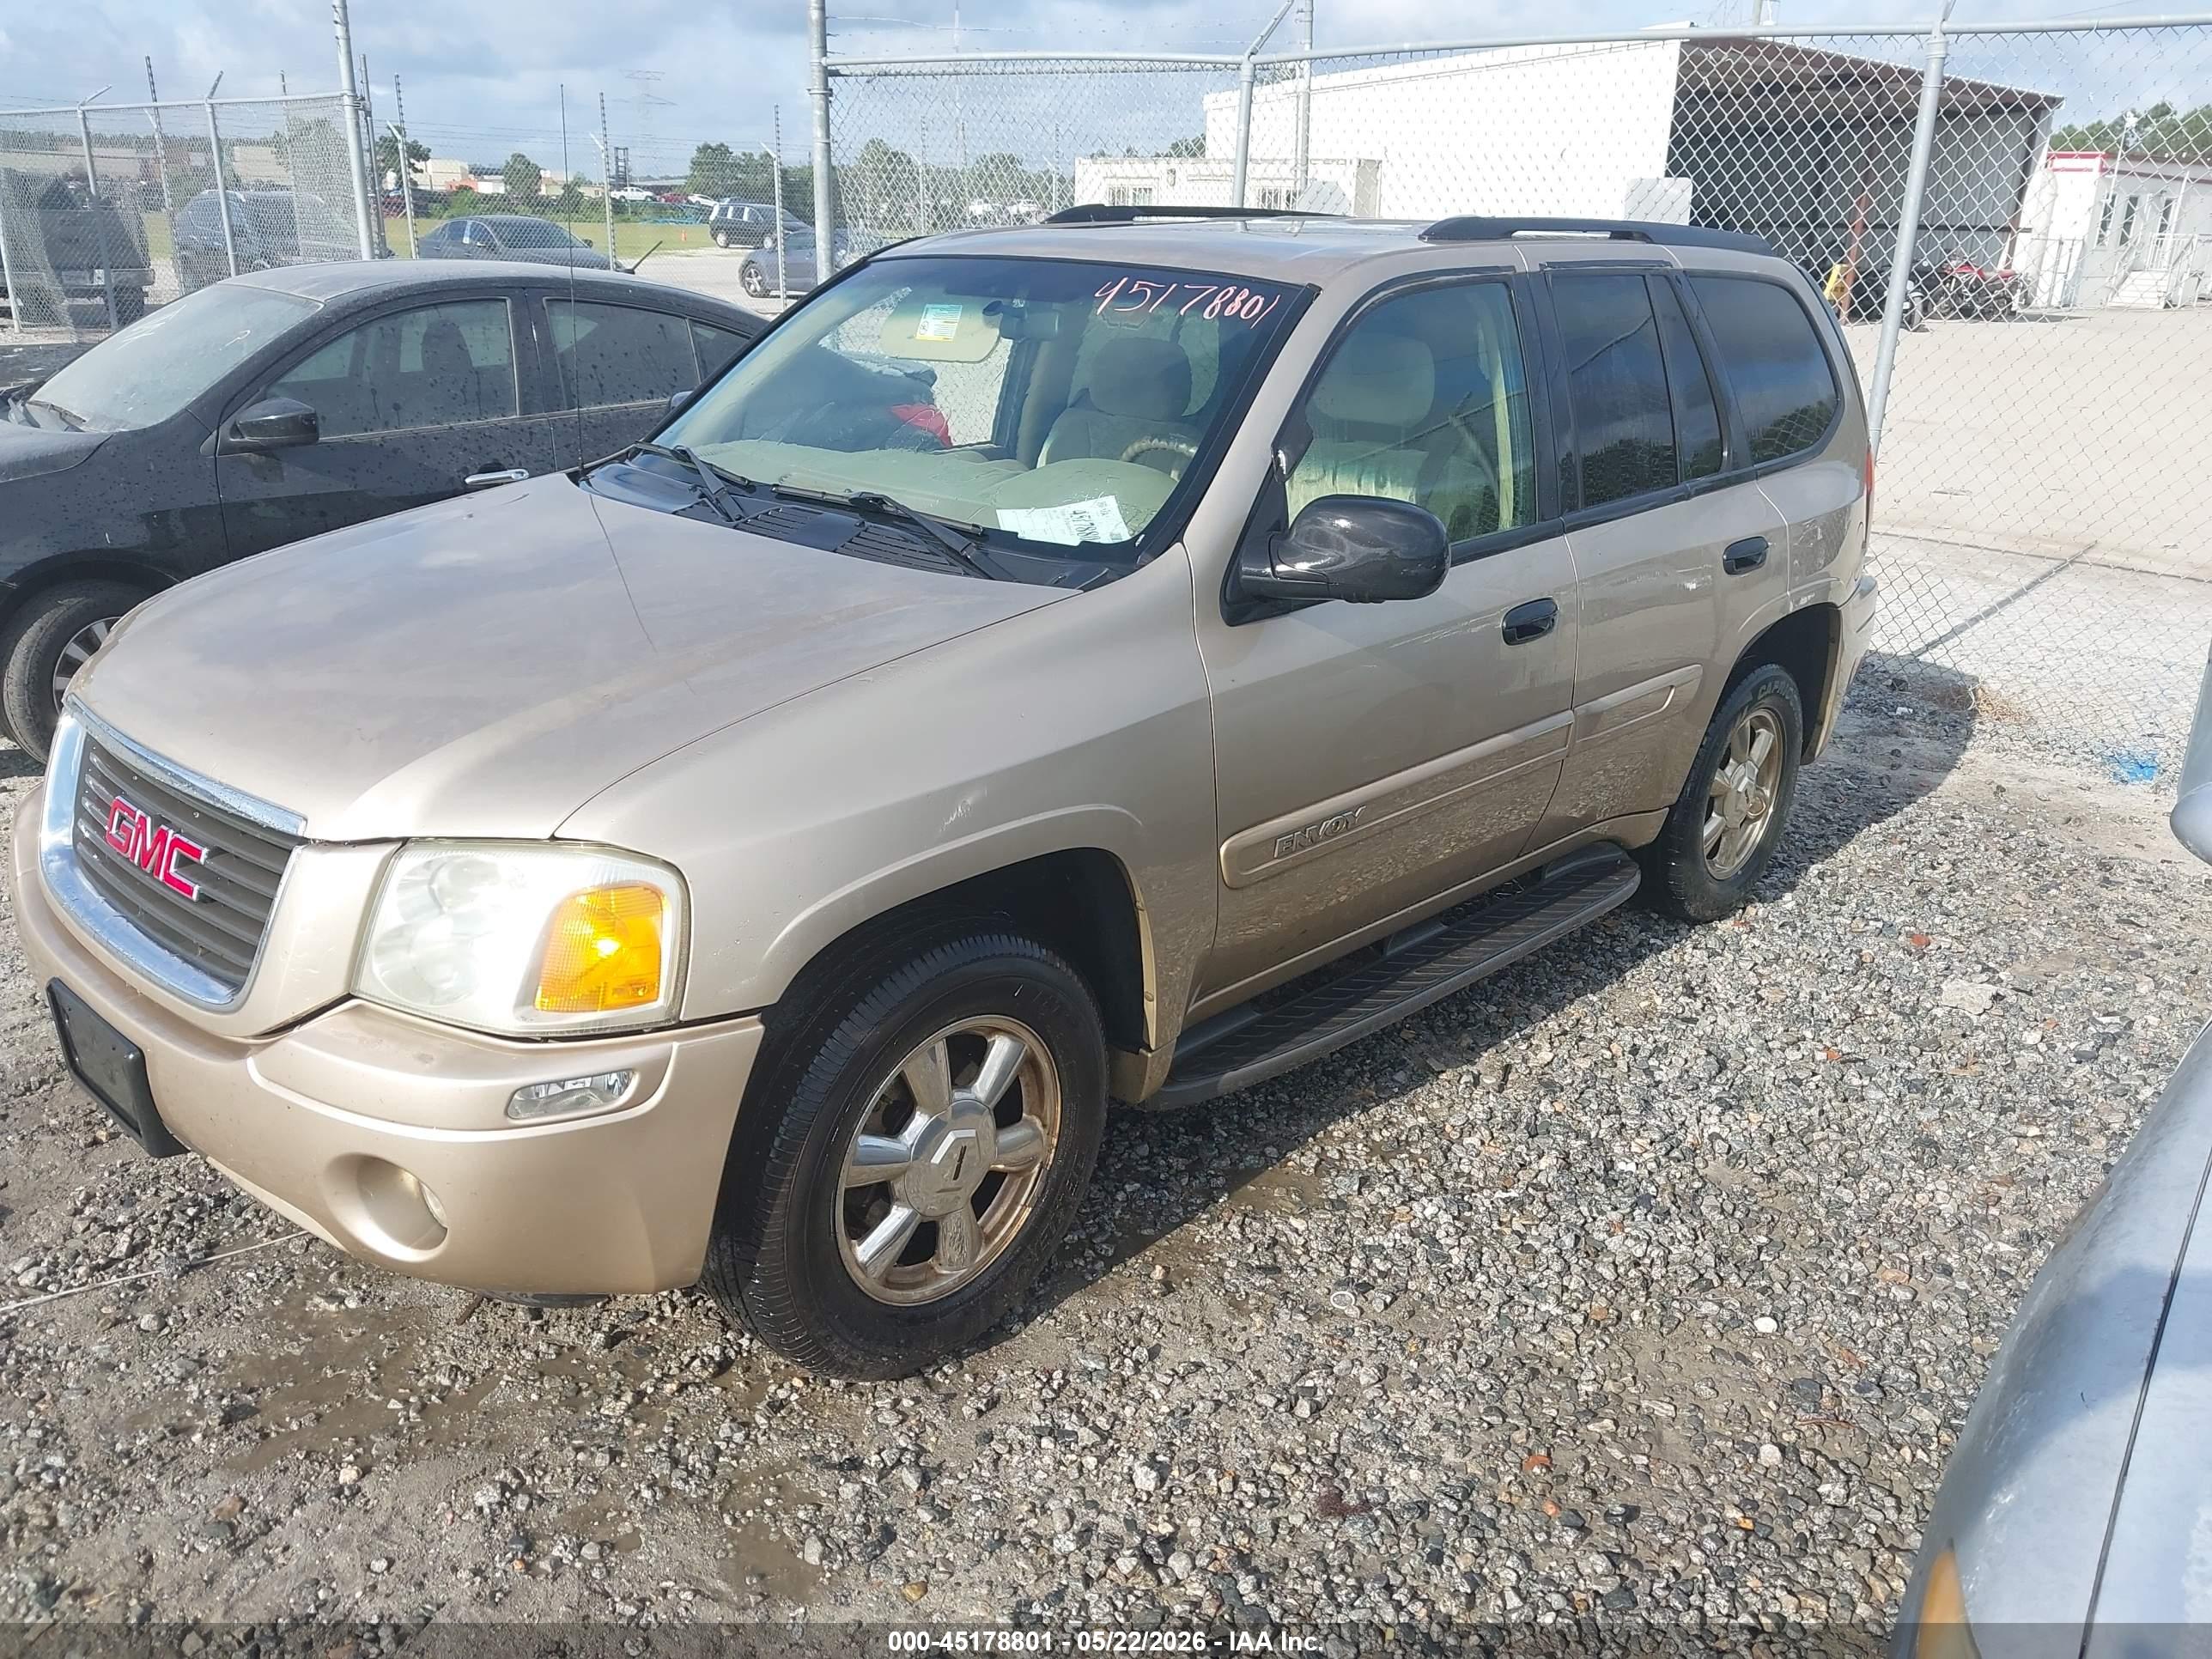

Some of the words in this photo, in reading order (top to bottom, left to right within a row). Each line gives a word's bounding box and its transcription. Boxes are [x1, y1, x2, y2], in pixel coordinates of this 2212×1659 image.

[1094, 276, 1281, 330] 45178801
[106, 795, 209, 902] GMC
[1273, 805, 1367, 859] ENVOY
